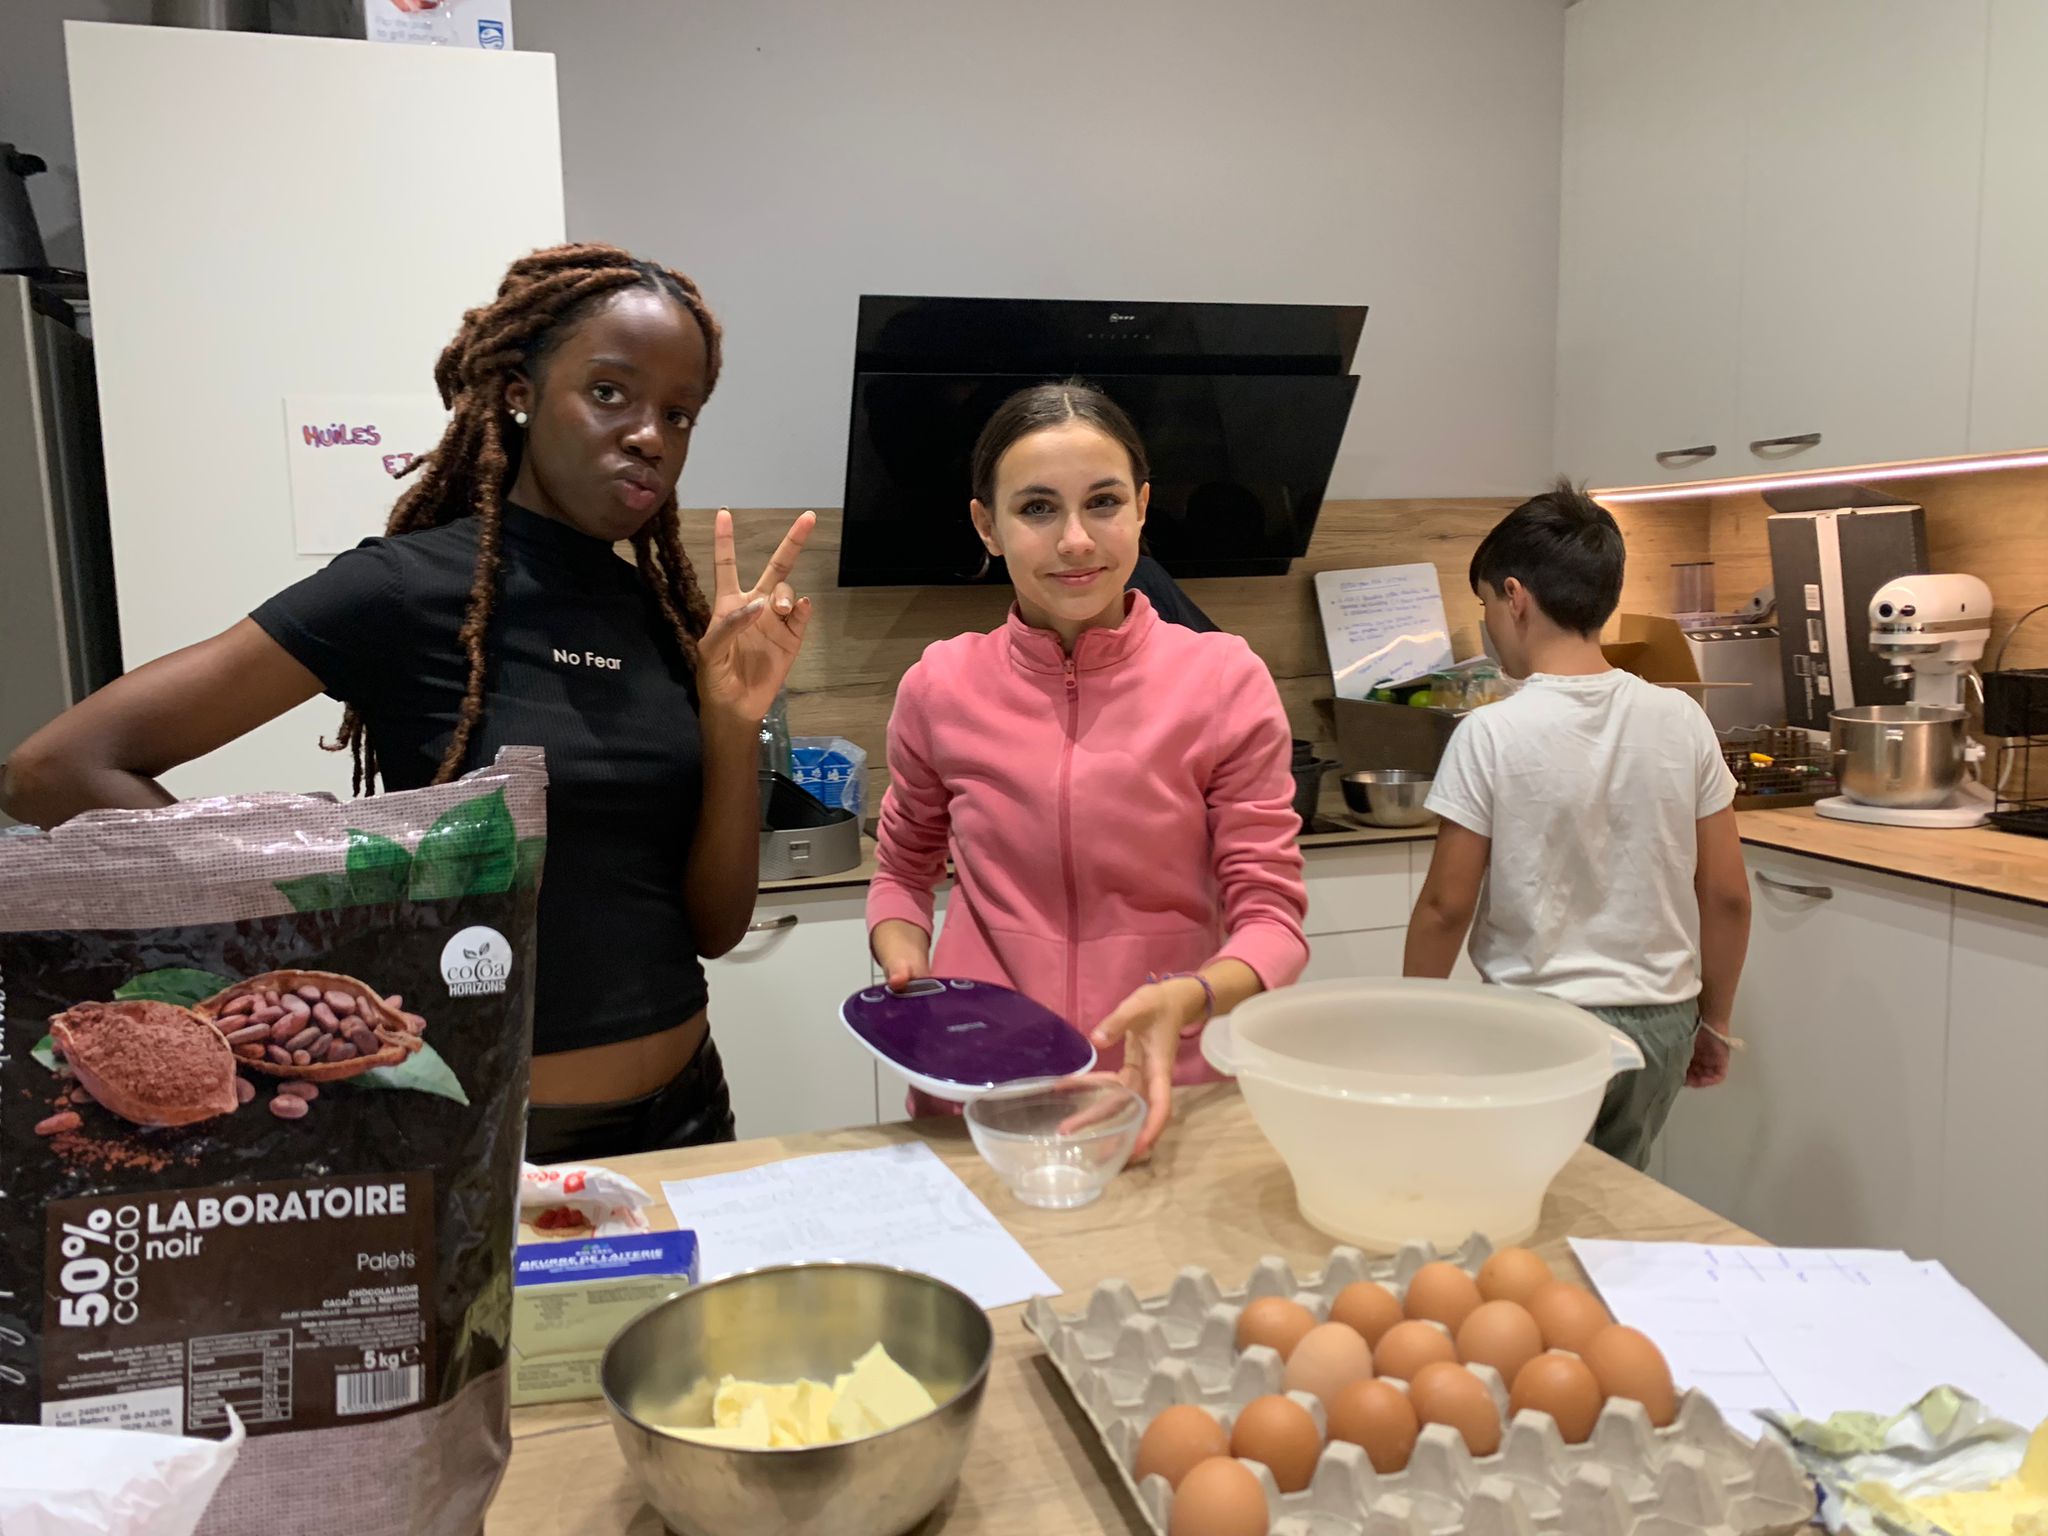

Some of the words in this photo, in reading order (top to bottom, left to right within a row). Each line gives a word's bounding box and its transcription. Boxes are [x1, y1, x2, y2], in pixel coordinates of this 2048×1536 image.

[552, 648, 581, 665] No
[584, 651, 622, 670] Fear
[448, 979, 506, 997] HORIZONS
[147, 1183, 406, 1234] LABORATOIRE
[146, 1232, 203, 1261] noir
[59, 1208, 112, 1327] 50%
[113, 1205, 141, 1325] cacao
[357, 1250, 416, 1271] Palets
[364, 1350, 377, 1370] 5
[378, 1352, 400, 1371] kg
